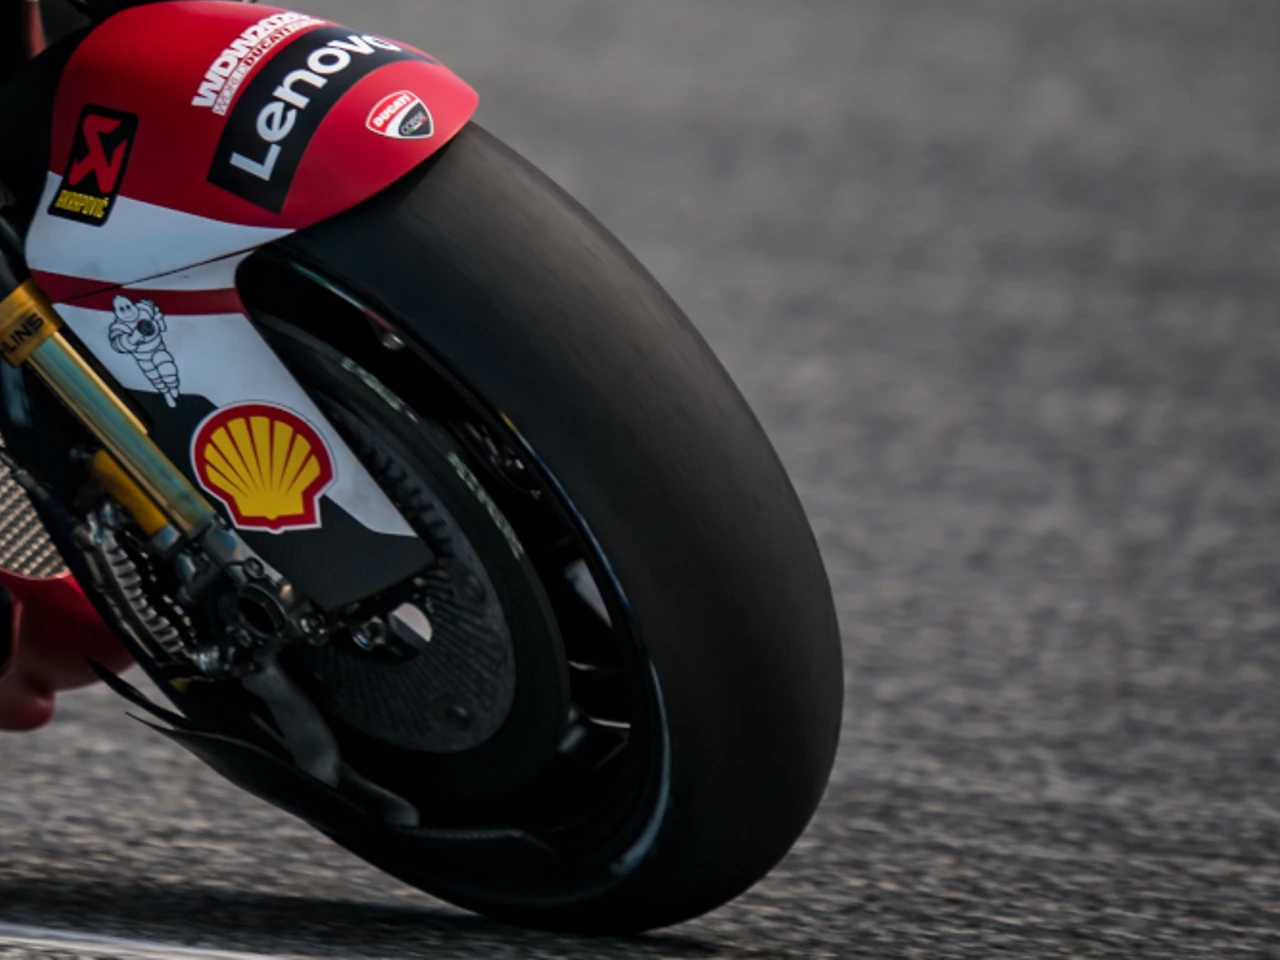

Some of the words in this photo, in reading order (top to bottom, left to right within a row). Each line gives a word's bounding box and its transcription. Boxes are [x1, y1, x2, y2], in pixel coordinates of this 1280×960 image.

[229, 34, 402, 182] Lenovo
[373, 94, 411, 126] DUCATI
[0, 313, 44, 354] LINS
